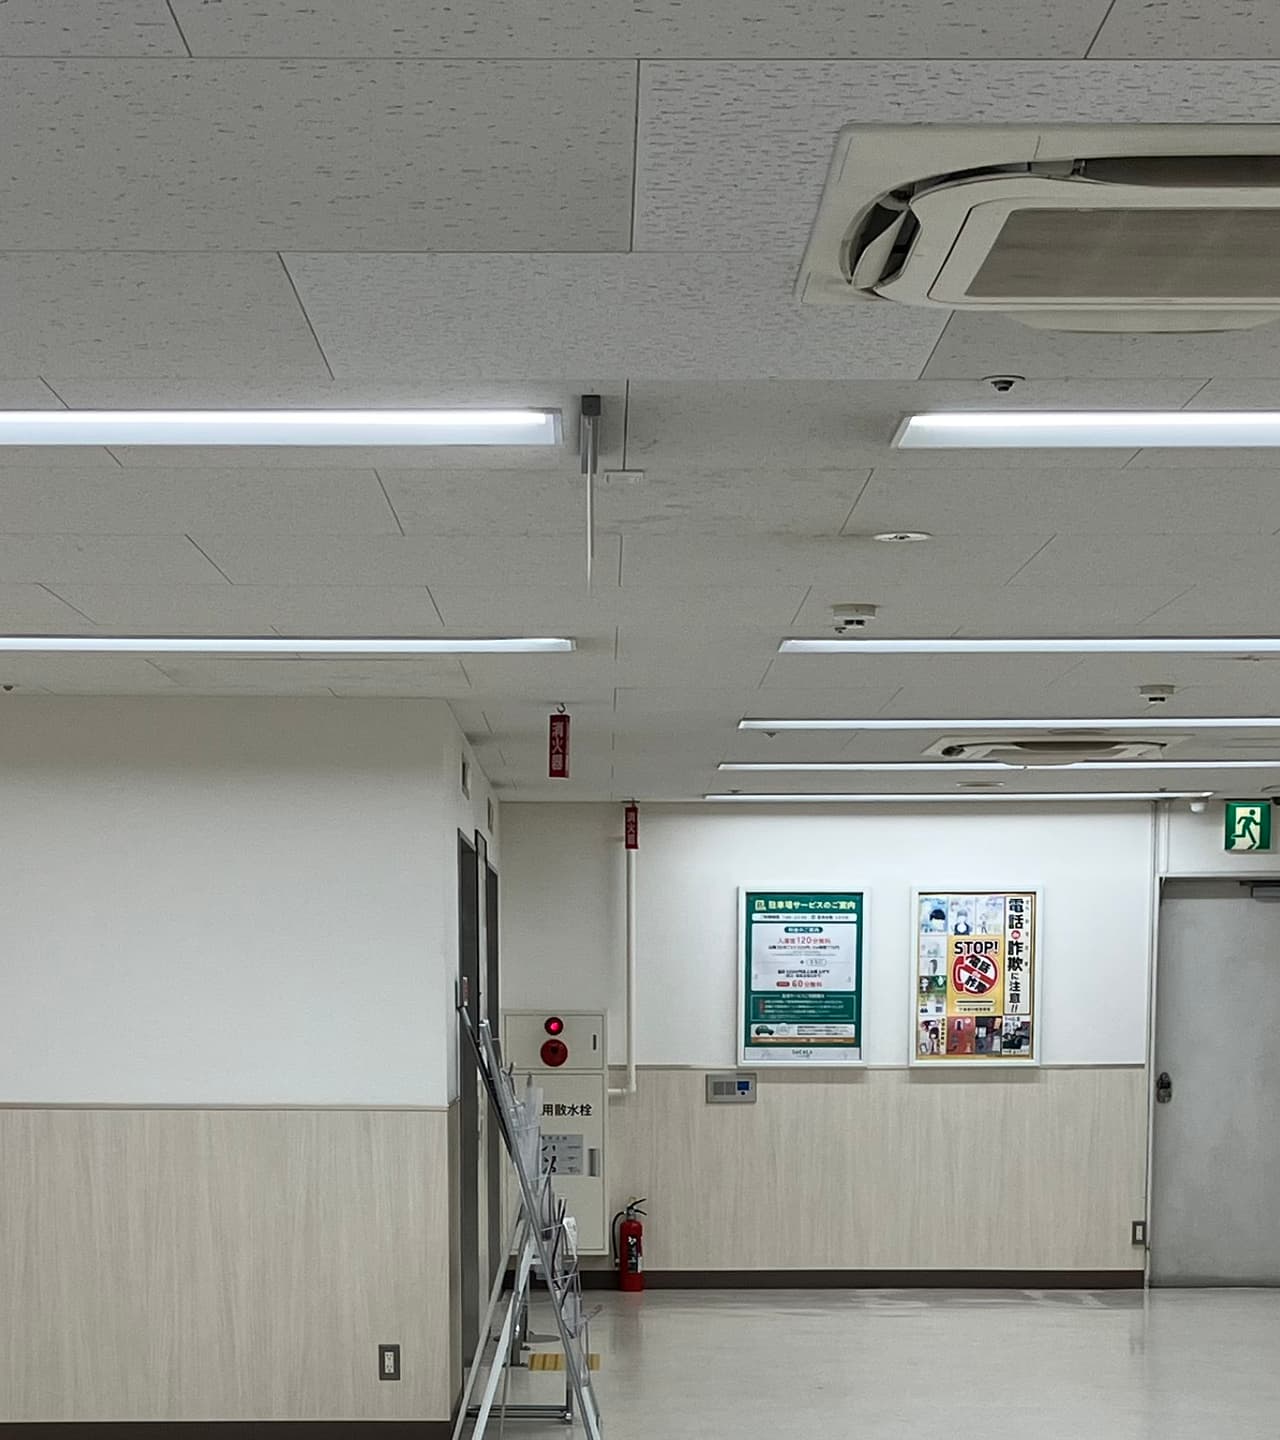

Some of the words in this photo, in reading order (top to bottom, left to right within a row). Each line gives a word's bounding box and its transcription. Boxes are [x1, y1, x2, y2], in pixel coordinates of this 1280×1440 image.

[551, 722, 564, 770] 消火器
[768, 900, 856, 911] 駐車場サービスのご案内
[954, 941, 998, 954] STOP!
